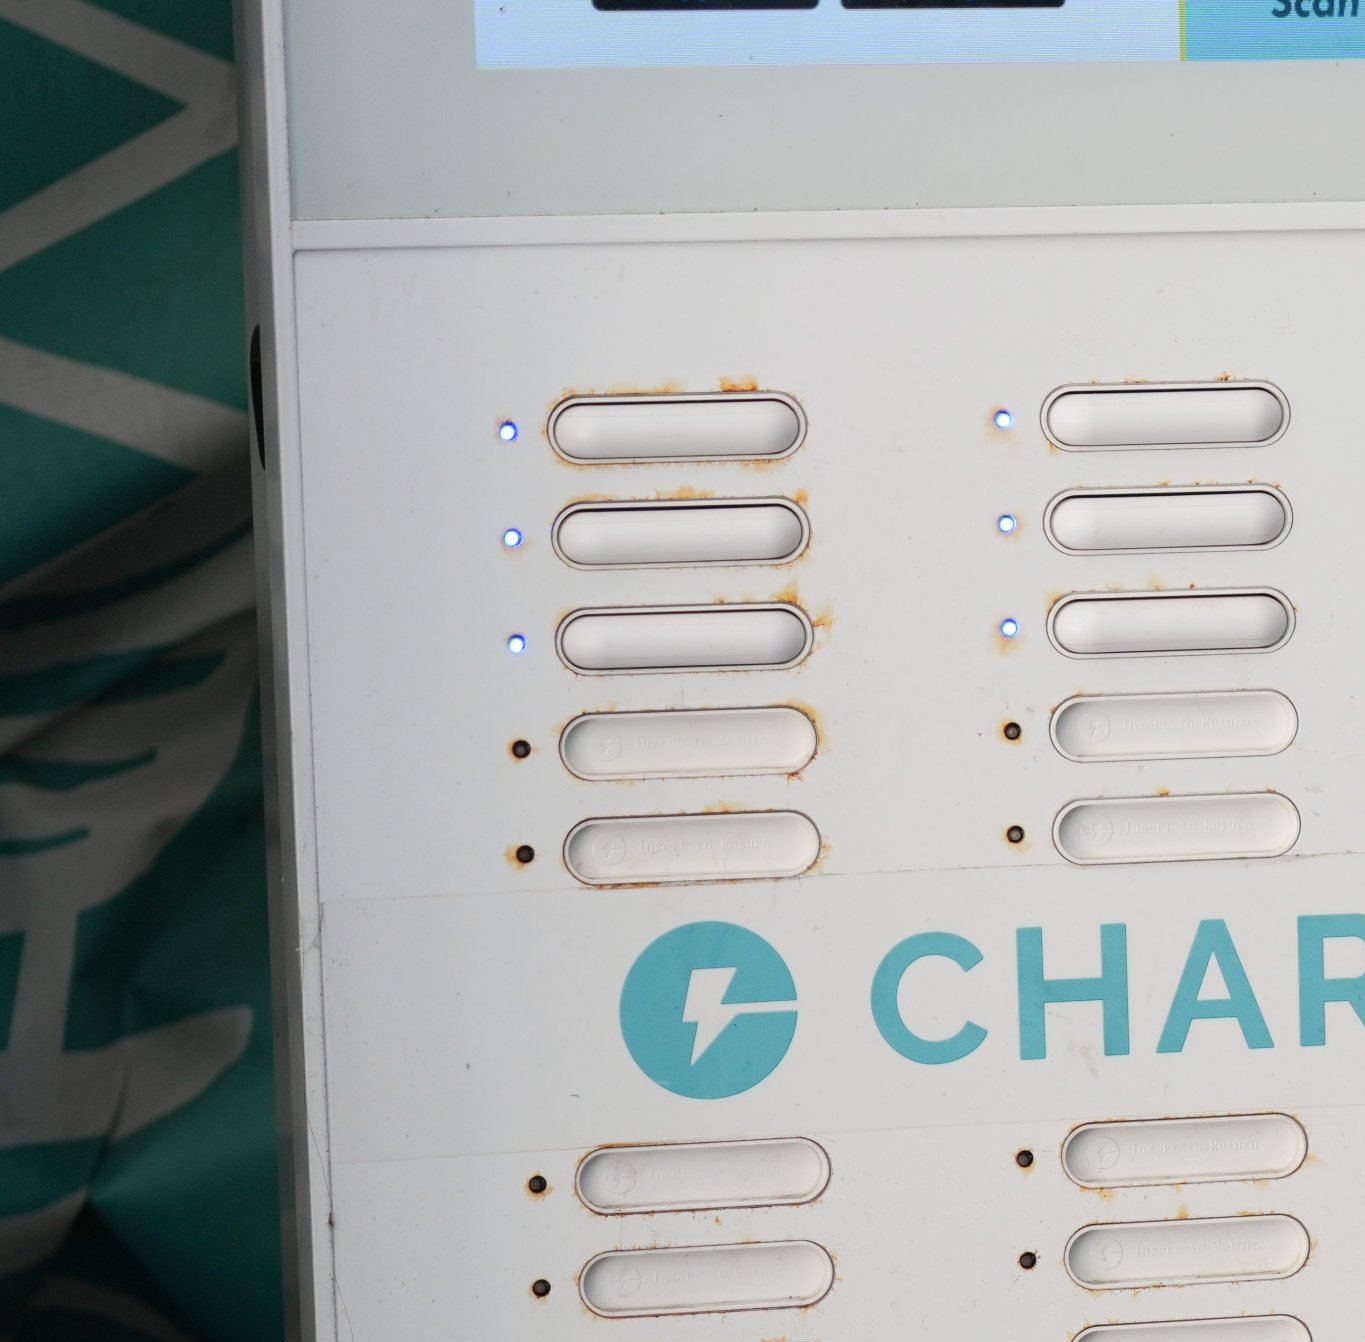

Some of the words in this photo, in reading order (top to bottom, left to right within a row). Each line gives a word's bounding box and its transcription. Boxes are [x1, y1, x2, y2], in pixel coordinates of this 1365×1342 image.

[1201, 716, 1250, 728] Return
[1211, 1140, 1258, 1151] Return
[1214, 1240, 1261, 1252] Return
